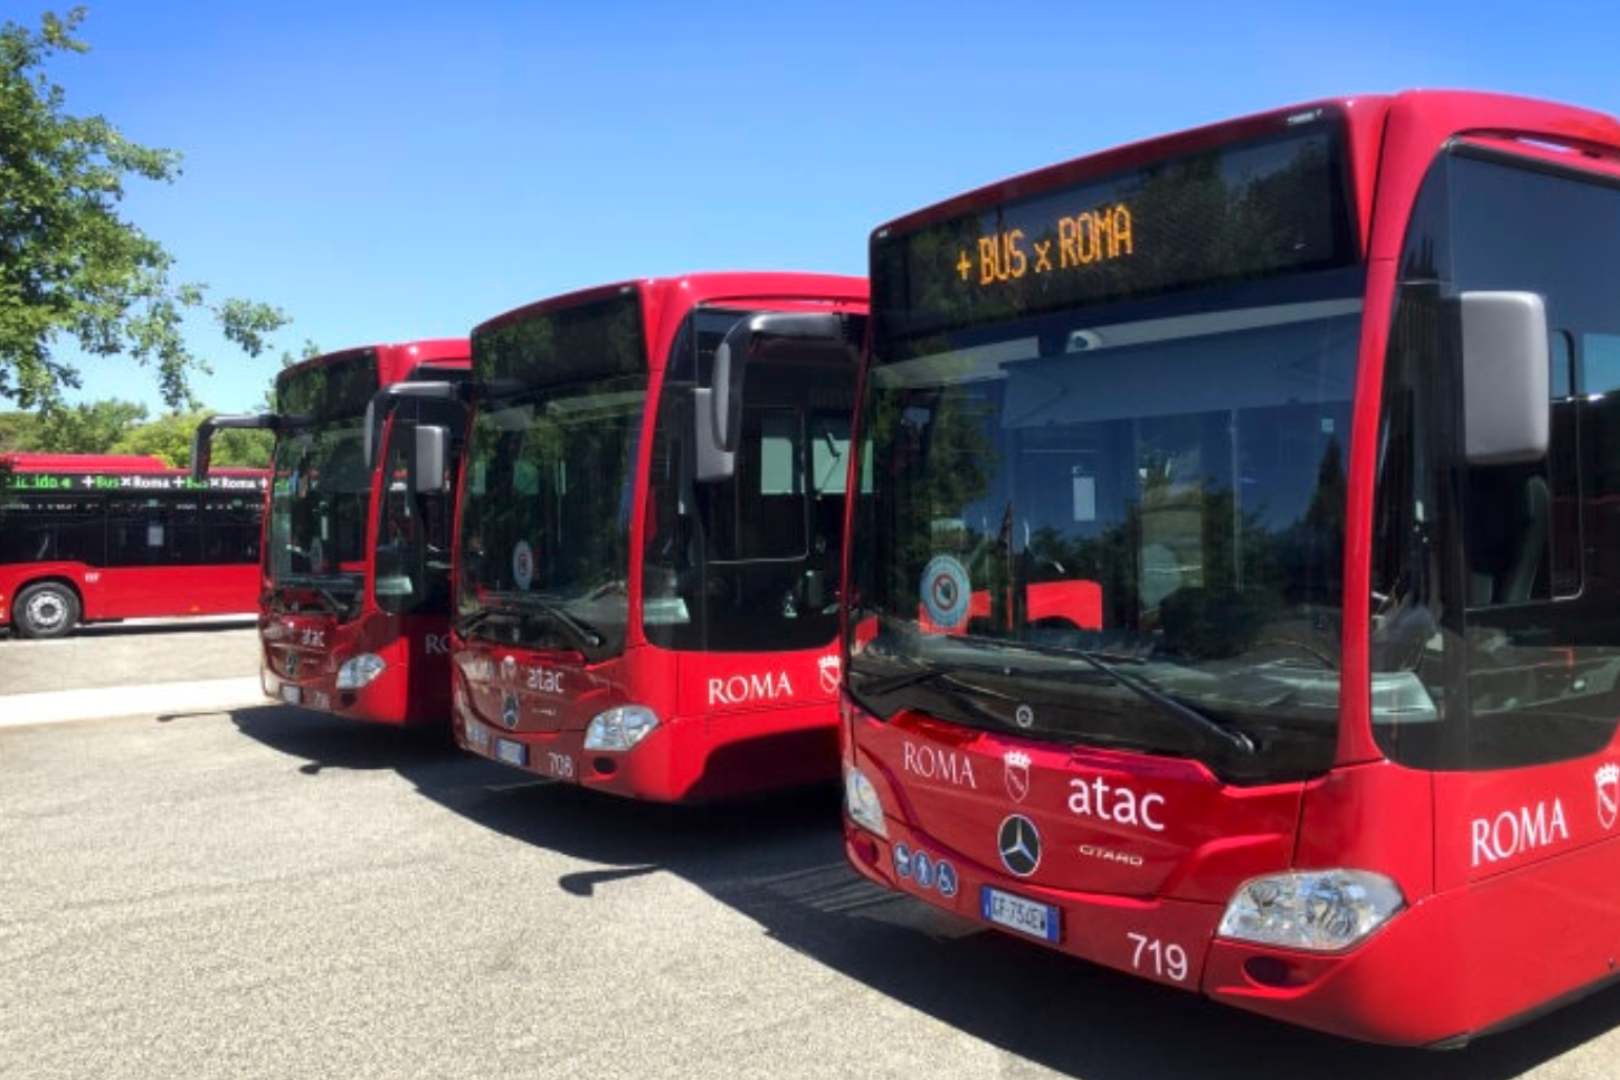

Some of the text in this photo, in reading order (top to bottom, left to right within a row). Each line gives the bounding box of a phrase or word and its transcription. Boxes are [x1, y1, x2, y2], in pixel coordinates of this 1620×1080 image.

[978, 228, 1027, 286] BUS
[1058, 203, 1132, 269] ROMA
[527, 665, 565, 694] atac
[708, 671, 793, 705] ROMA
[903, 741, 977, 789] ROMA
[1067, 776, 1165, 830] atac
[1471, 797, 1568, 867] ROMA
[1126, 932, 1188, 982] 719
